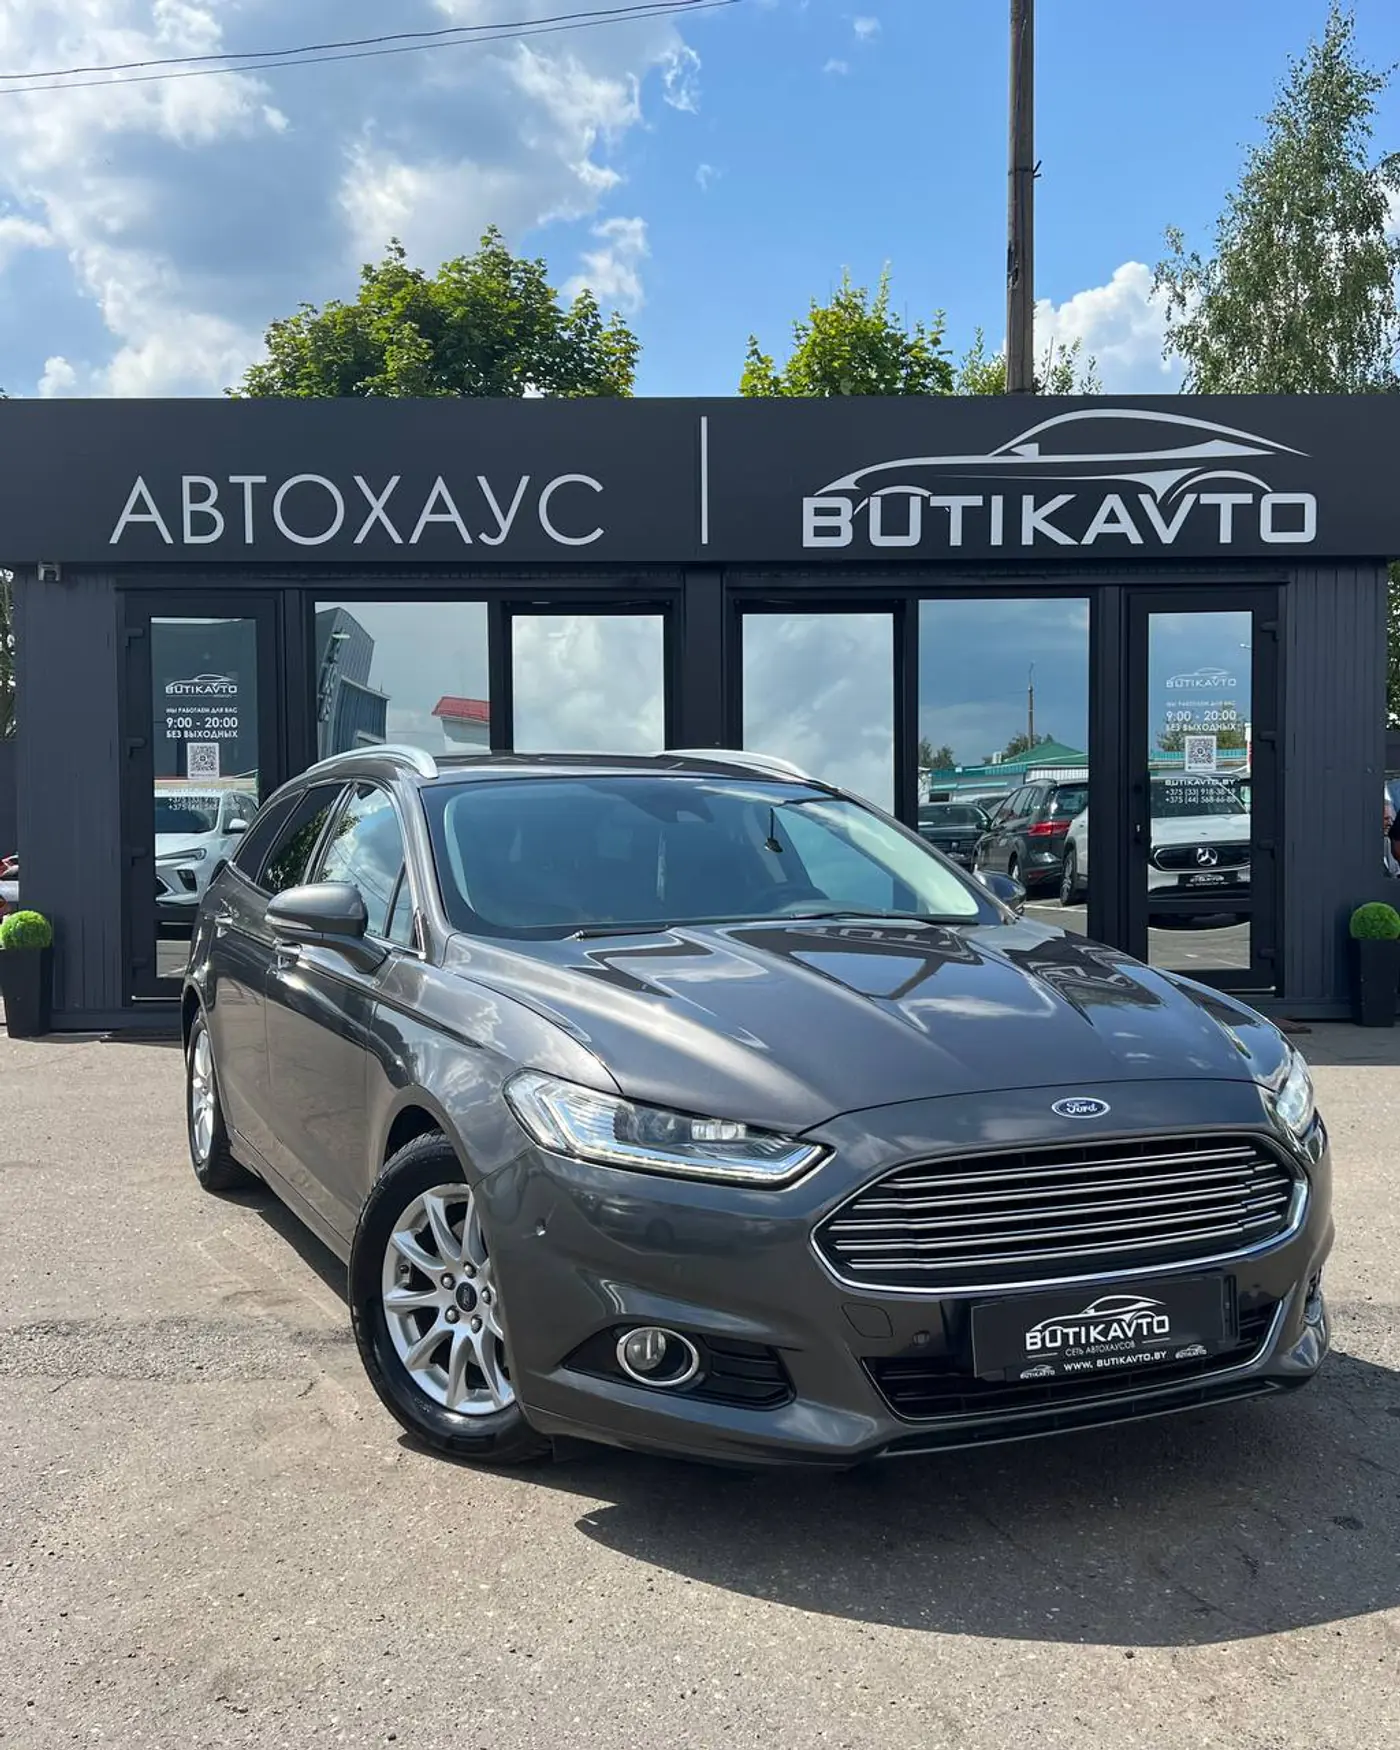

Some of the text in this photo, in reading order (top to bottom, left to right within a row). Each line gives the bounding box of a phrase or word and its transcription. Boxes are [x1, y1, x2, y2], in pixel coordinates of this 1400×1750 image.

[109, 474, 605, 546] АВТОХАУС
[803, 493, 1317, 548] BUTIKAVTO
[165, 685, 238, 694] BUTIKAVTO
[1165, 679, 1237, 688] BUTIKAVTO
[166, 717, 192, 728] 9:00
[204, 717, 238, 728] 20:00
[166, 729, 238, 739] БЕЗ ВЫХОДНЫХ
[1065, 1101, 1098, 1114] Ford
[1025, 1315, 1170, 1350] BUTIKAVTO
[1065, 1340, 1136, 1358] СЕТЬ АВТОХАУСОВ
